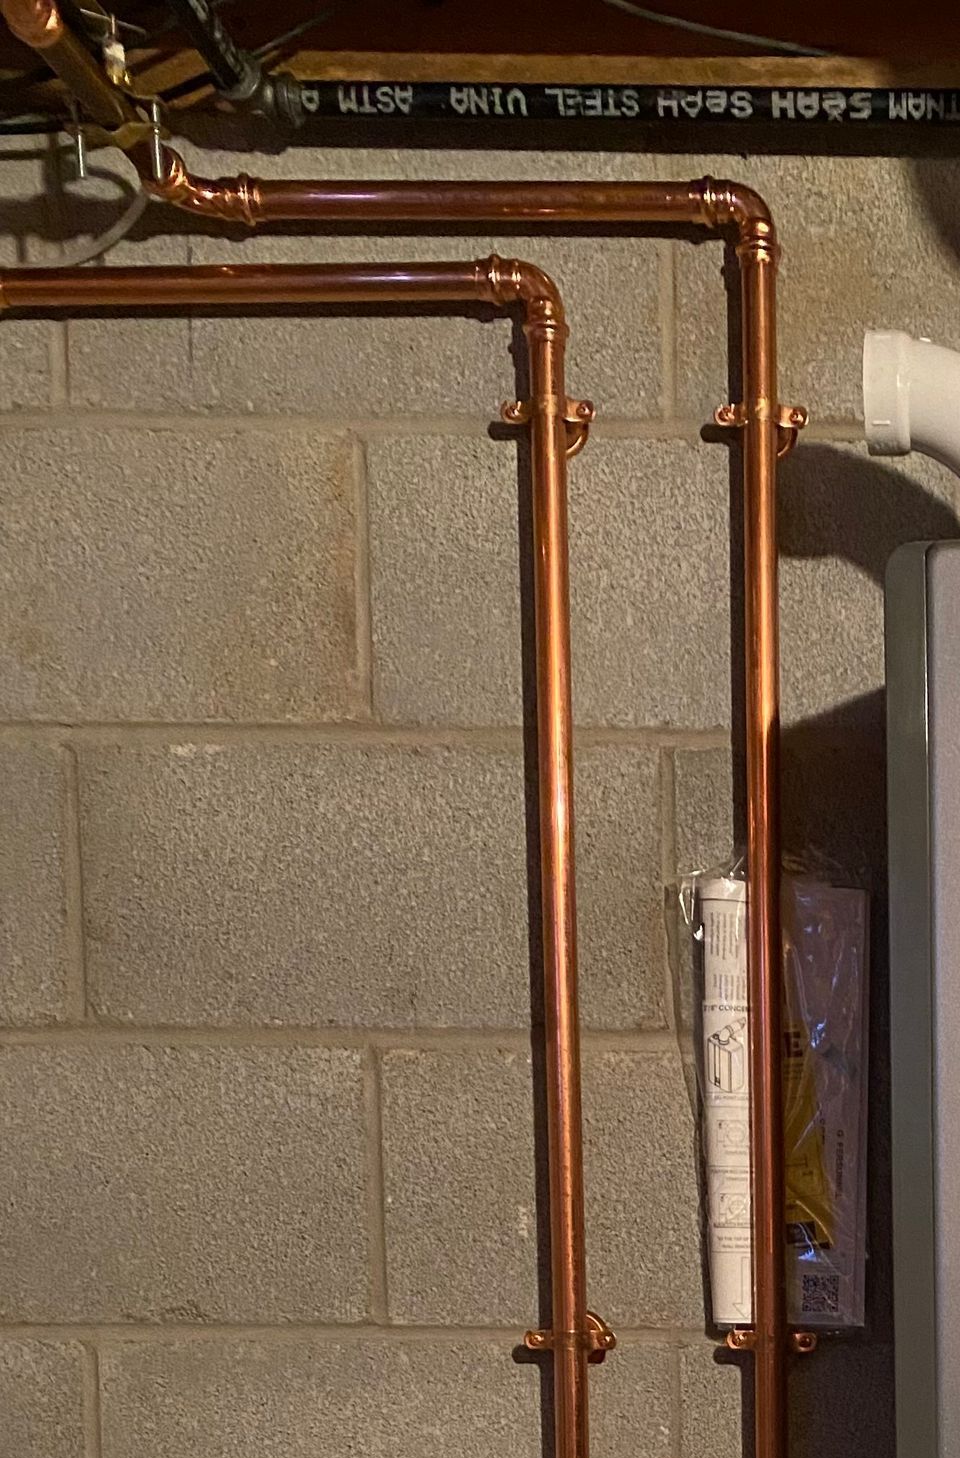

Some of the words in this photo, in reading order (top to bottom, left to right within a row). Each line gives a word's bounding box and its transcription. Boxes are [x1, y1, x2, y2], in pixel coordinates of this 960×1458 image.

[337, 84, 414, 115] ASTM
[449, 86, 529, 117] VINA
[543, 87, 641, 118] STEEL
